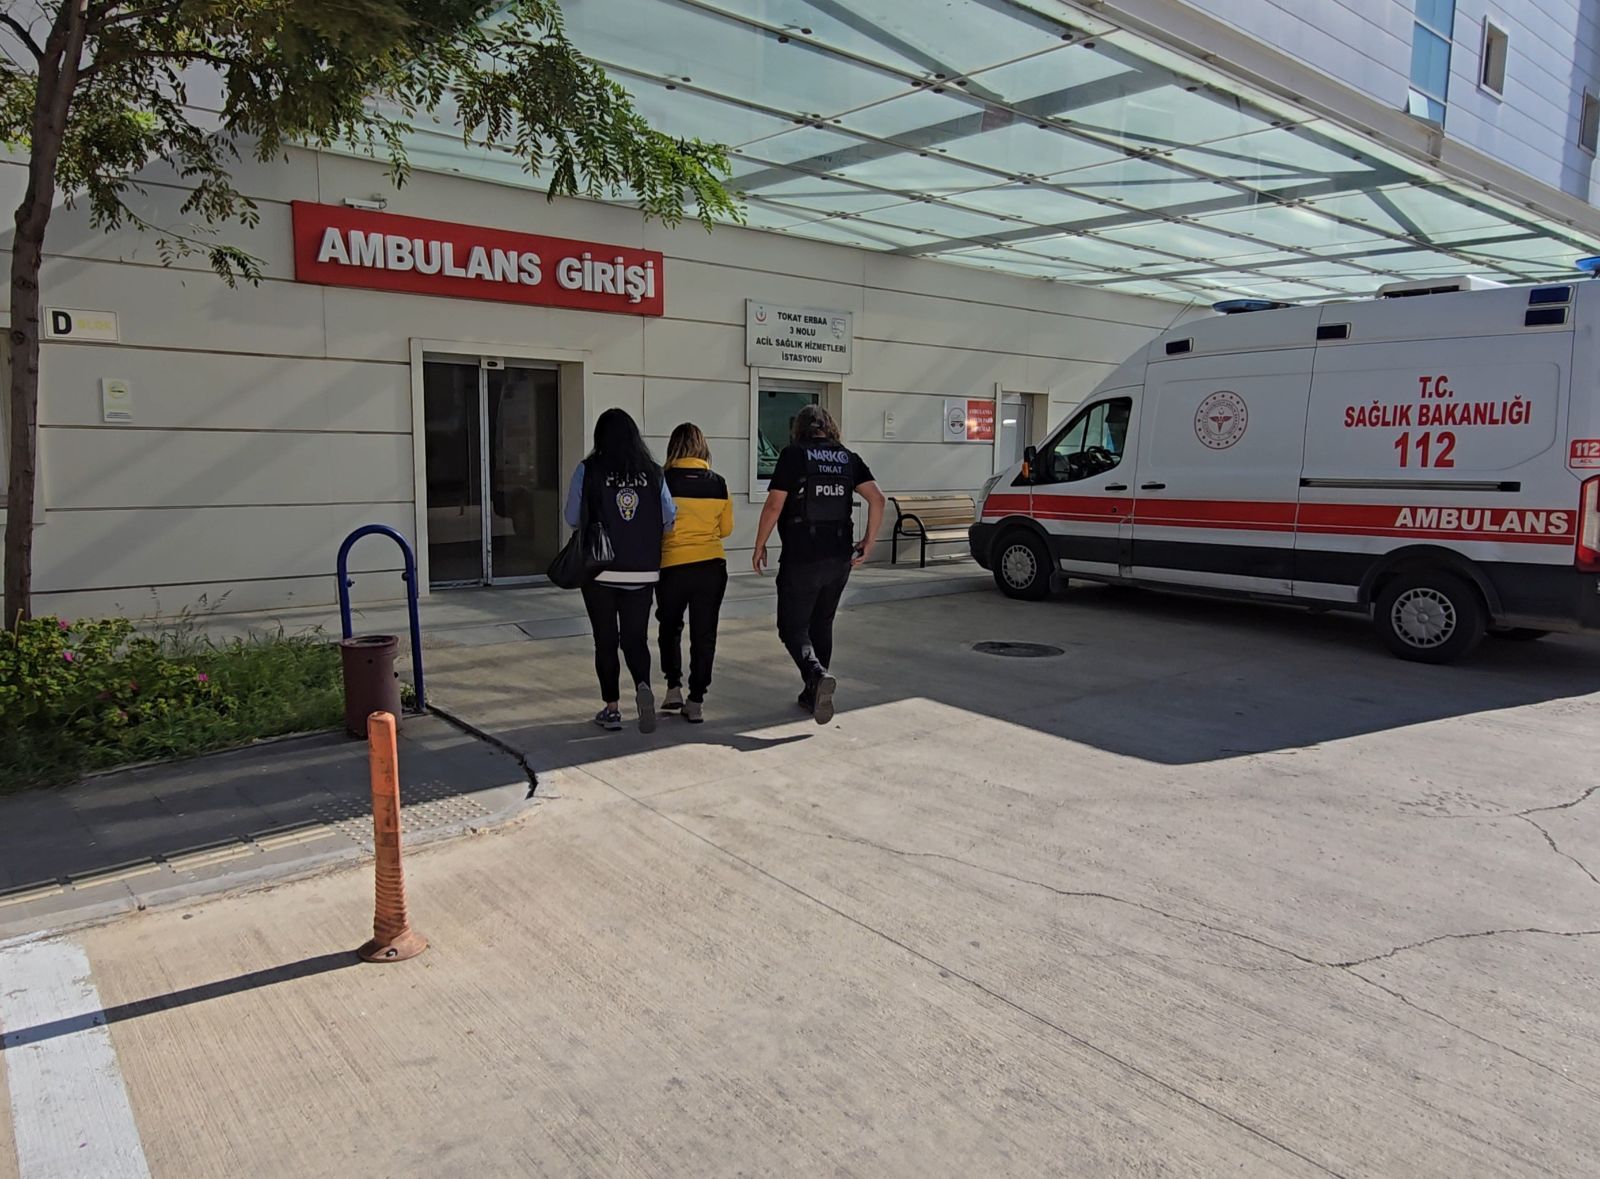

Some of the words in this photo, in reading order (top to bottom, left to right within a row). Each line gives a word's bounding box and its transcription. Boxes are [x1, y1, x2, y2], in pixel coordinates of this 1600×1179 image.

[317, 226, 542, 286] AMBULANS
[556, 251, 655, 303] GİRİŞİ
[52, 310, 72, 335] D
[777, 311, 802, 323] TOKAT
[803, 315, 828, 326] ERBAA
[789, 326, 795, 335] 3
[796, 326, 816, 337] NOLU
[756, 336, 773, 346] ACİL
[775, 338, 803, 349] SAĞLIK
[804, 340, 847, 353] HİZMETLERİ
[781, 351, 823, 364] İSTASYONU
[1419, 375, 1453, 399] T.C.
[1344, 400, 1413, 428] SAĞLIK
[1418, 395, 1532, 427] BAKANLIĞI
[1394, 431, 1456, 468] 112
[1575, 442, 1600, 457] 112
[817, 464, 843, 474] TOKAT
[815, 483, 845, 497] POLİS
[1394, 507, 1569, 535] AMBULANS
